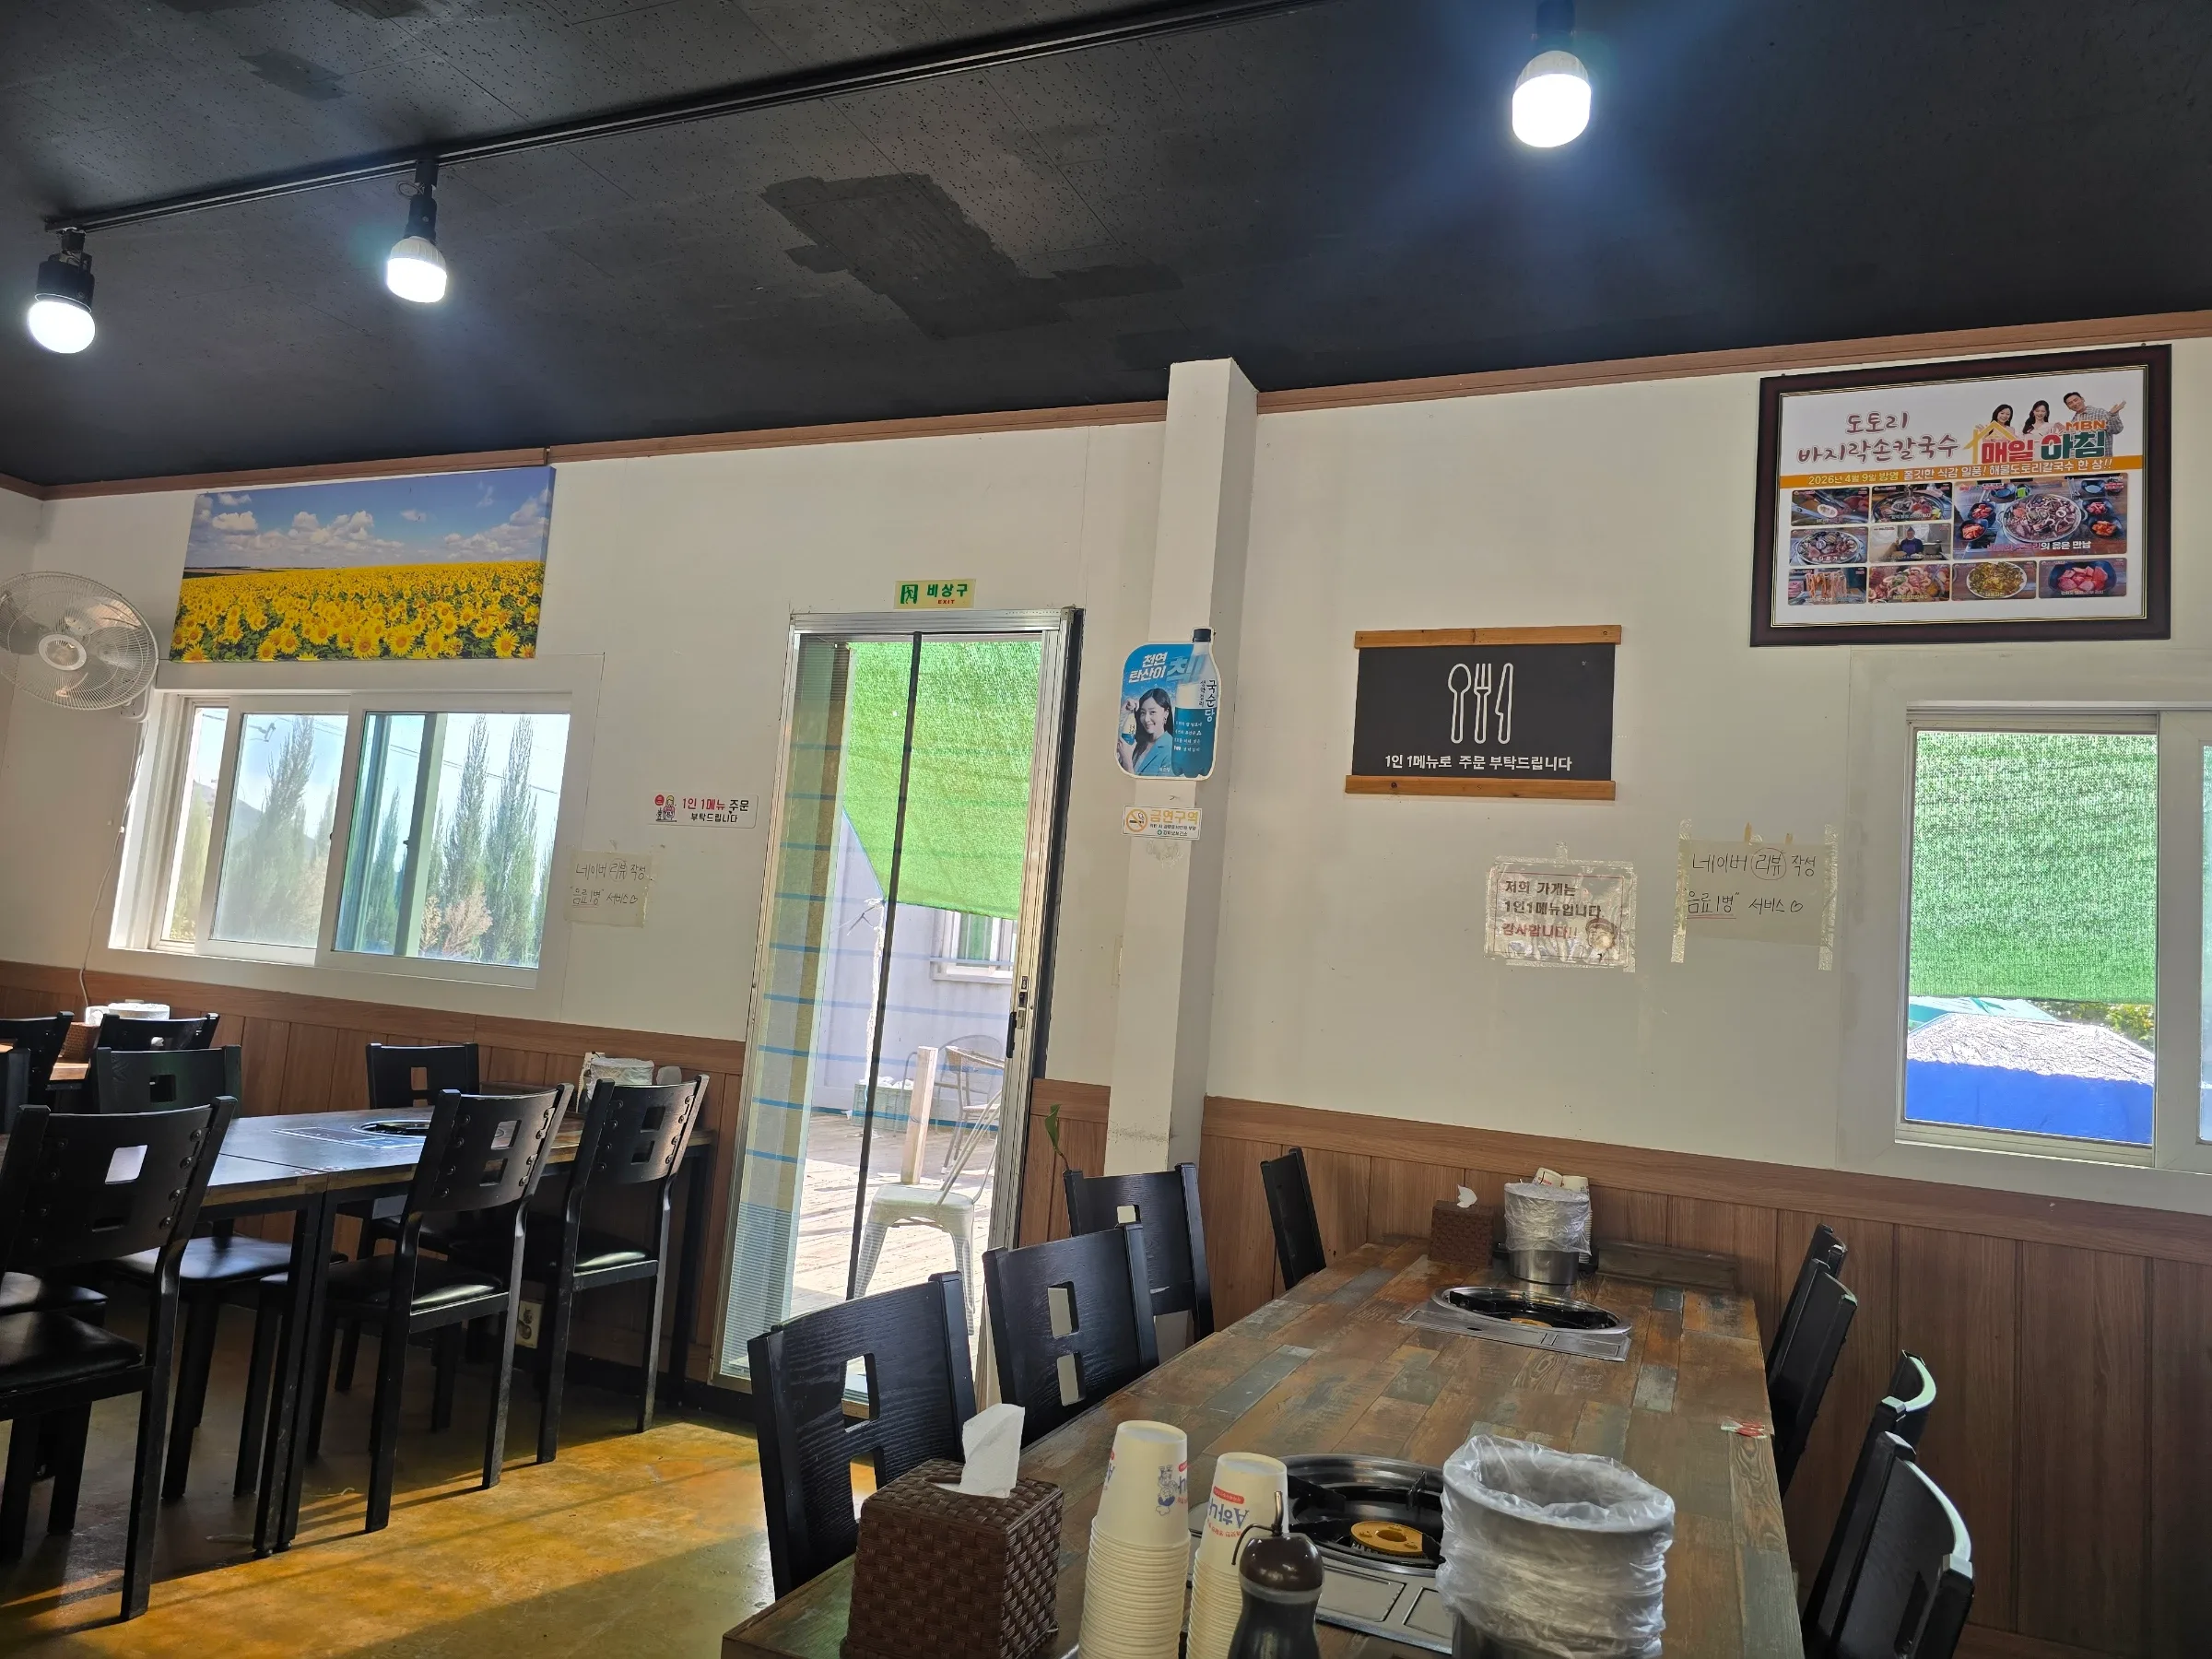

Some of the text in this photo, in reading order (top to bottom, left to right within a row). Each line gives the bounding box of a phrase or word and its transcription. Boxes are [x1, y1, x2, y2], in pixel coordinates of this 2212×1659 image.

[1846, 411, 1910, 434] 도토리
[2065, 419, 2106, 431] MBN
[1797, 433, 1959, 463] 바지락손칼국수
[1981, 430, 2106, 465] 매일 아침
[1808, 459, 2112, 486] 2026년 4월 9일 방영 쫄깃한 식감 일품! 해물도토리칼국수 한 상!!
[926, 583, 968, 597] 비상구
[1142, 652, 1168, 668] 천연
[1128, 665, 1166, 683] 탄산이
[1205, 679, 1218, 723] 국순당
[1385, 754, 1572, 771] 1인 1메뉴로 주문 부탁드립니다
[682, 797, 749, 812] 1인 1메뉴 주문
[690, 813, 738, 823] 부탁드립니다
[1150, 809, 1198, 825] 금연구역
[575, 862, 646, 881] 네이버 리뷰 작성
[1692, 853, 1817, 877] 네이버 리뷰 작성
[1505, 880, 1577, 897] 저희 가게는
[606, 892, 629, 905] 서비스
[1748, 898, 1785, 915] 서비스
